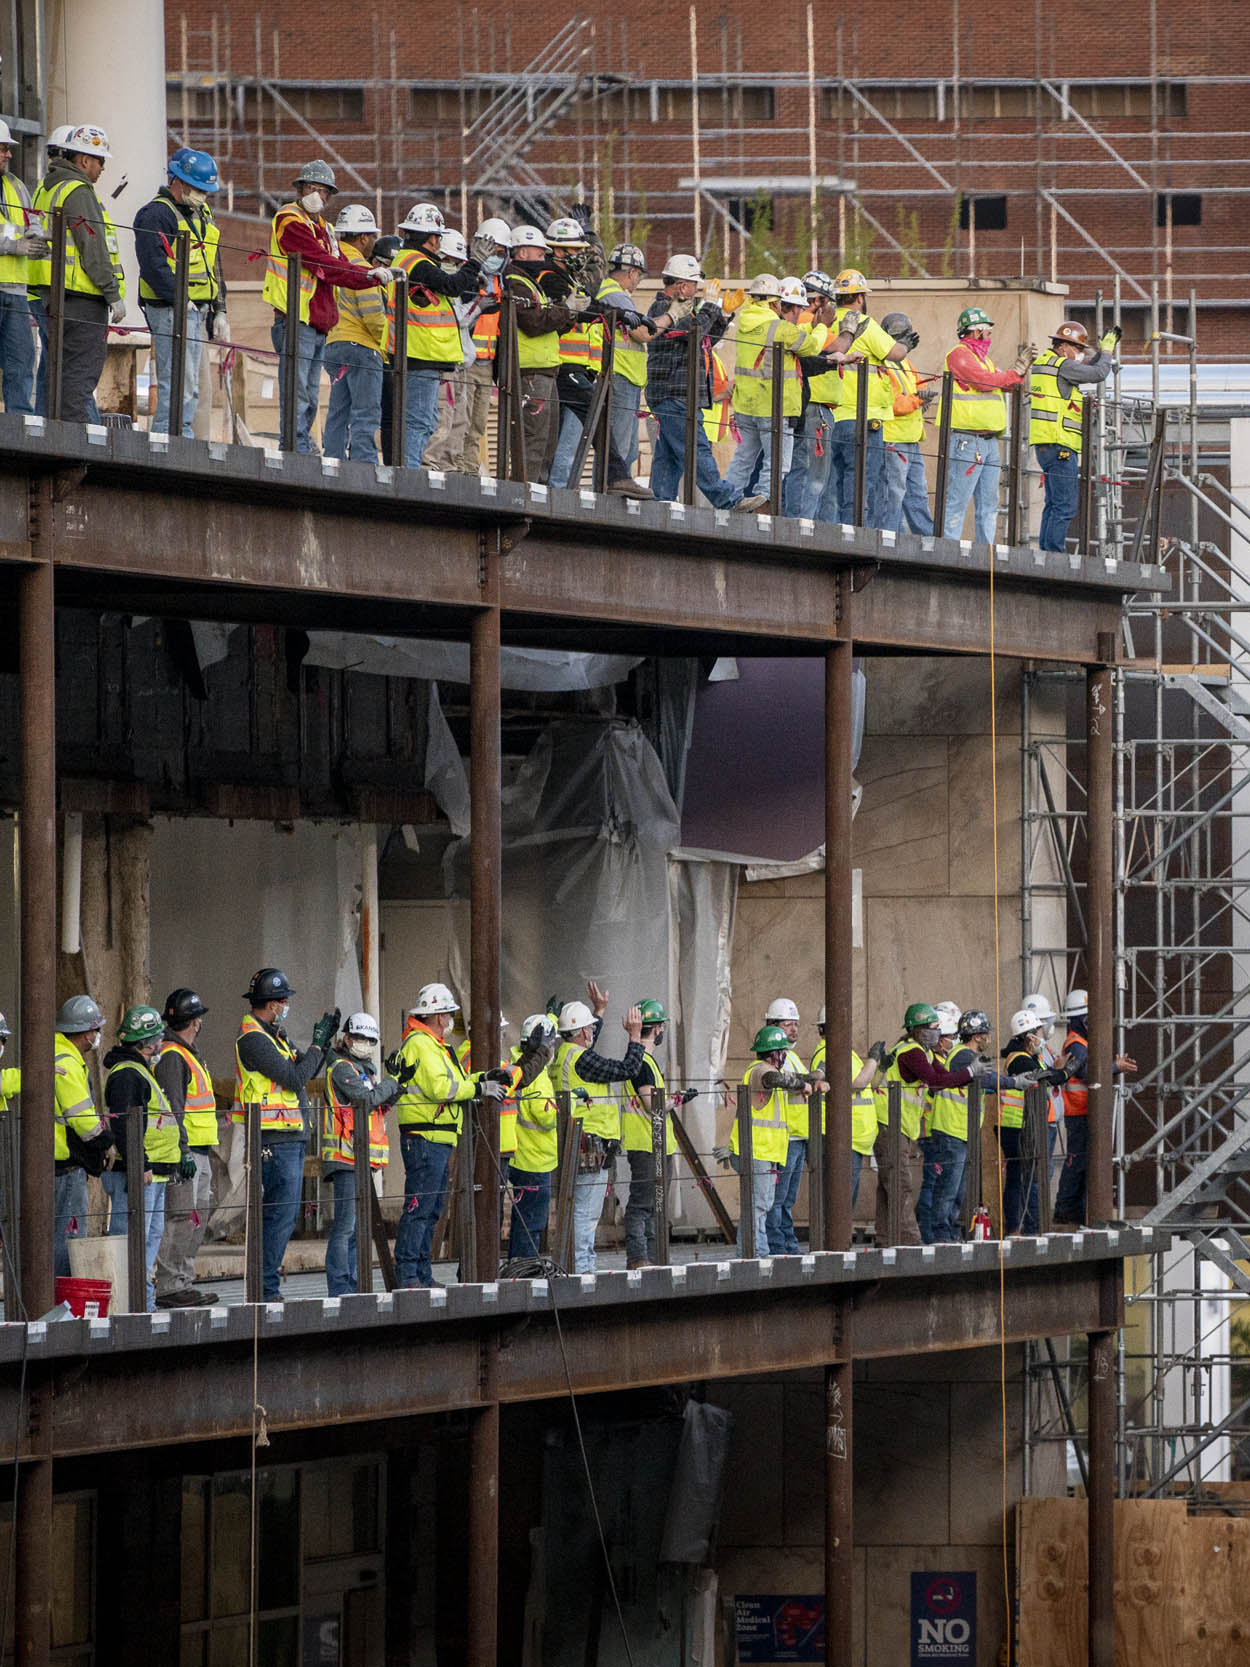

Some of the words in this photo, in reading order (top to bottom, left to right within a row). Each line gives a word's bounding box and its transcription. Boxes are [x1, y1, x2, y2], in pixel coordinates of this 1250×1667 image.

[736, 1600, 760, 1609] Clean
[736, 1609, 752, 1617] Air
[736, 1616, 771, 1625] Medical
[736, 1624, 758, 1632] Zone
[918, 1618, 970, 1644] NO
[917, 1644, 970, 1653] SMOKING
